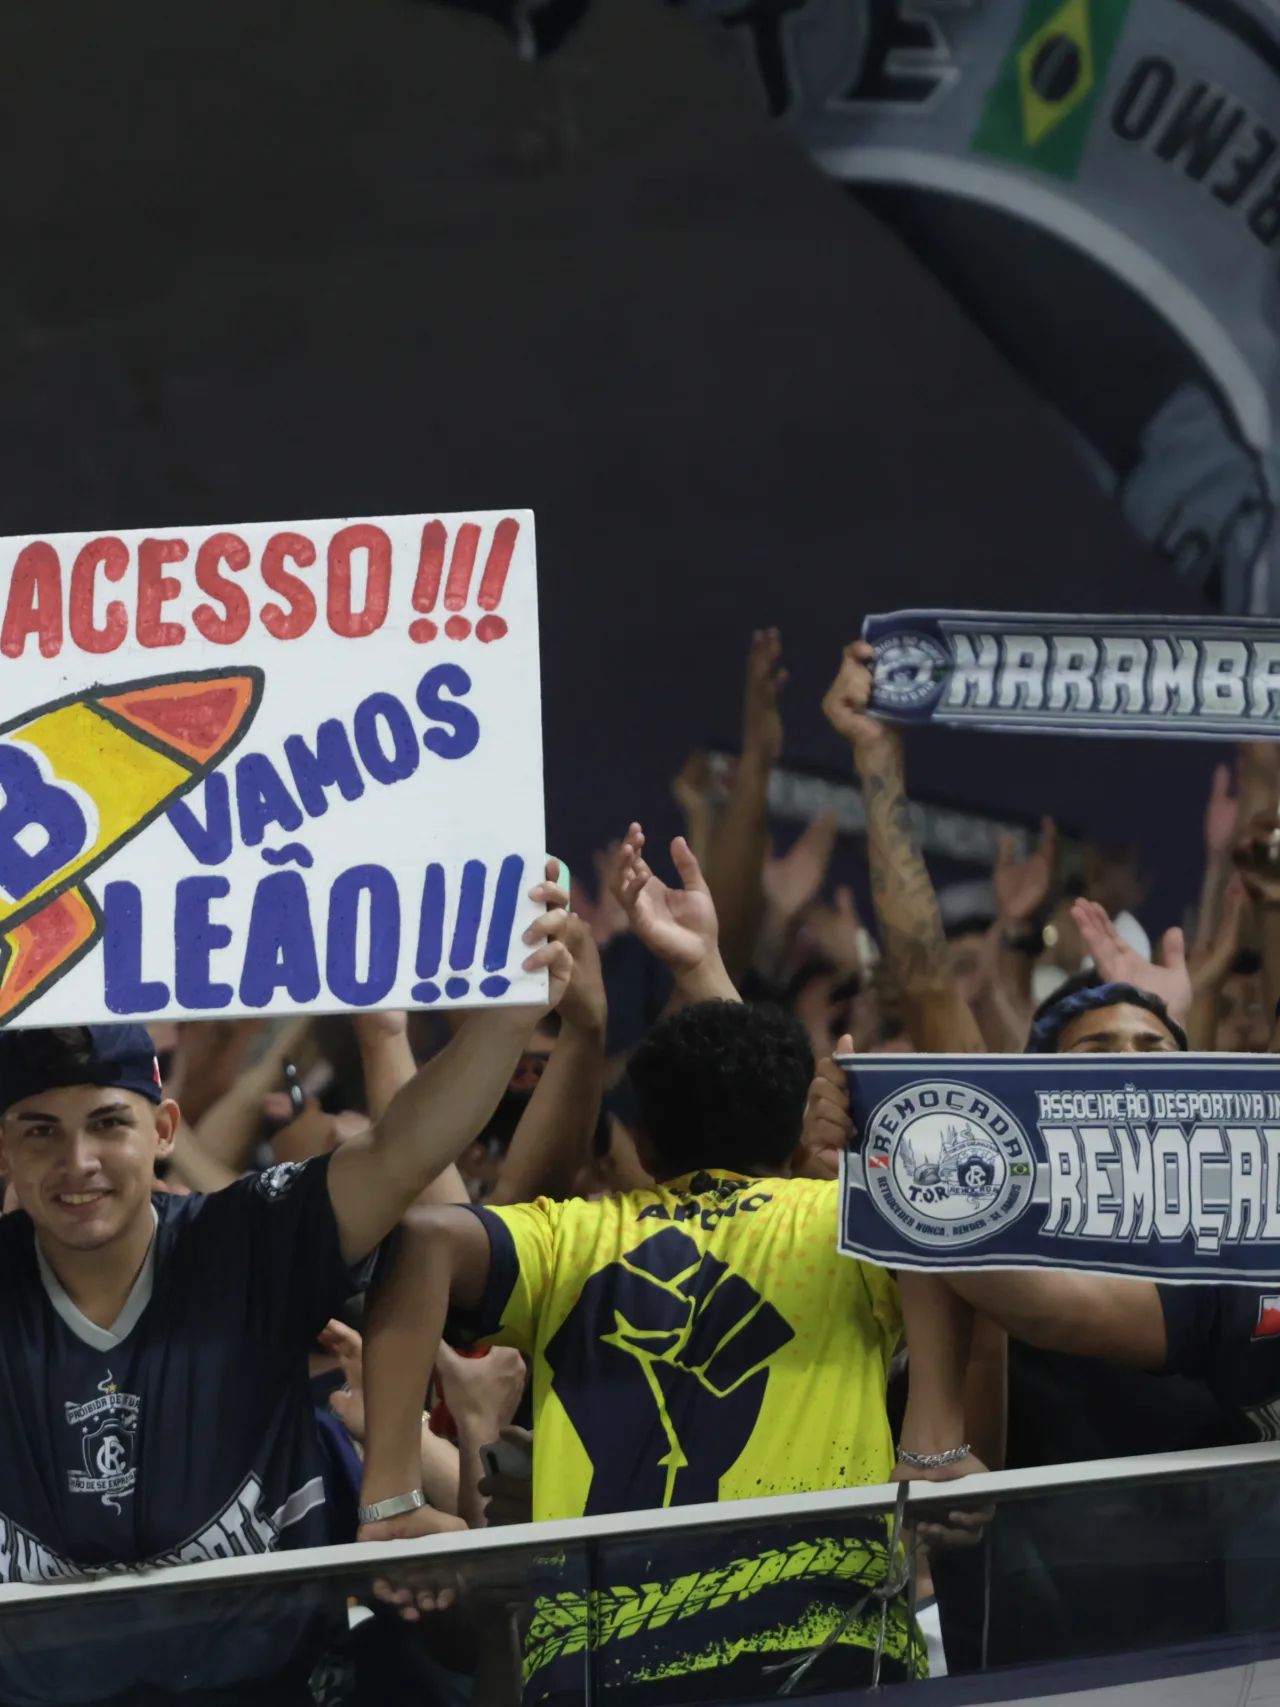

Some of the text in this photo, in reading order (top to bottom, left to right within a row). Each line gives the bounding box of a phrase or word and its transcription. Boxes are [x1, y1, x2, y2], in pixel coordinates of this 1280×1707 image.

[166, 664, 479, 865] VAMOS
[1039, 1085, 1150, 1121] ASSOCIAÇÃO
[1153, 1093, 1265, 1120] DESPORTIVA
[67, 1397, 108, 1421] PROIBIDA
